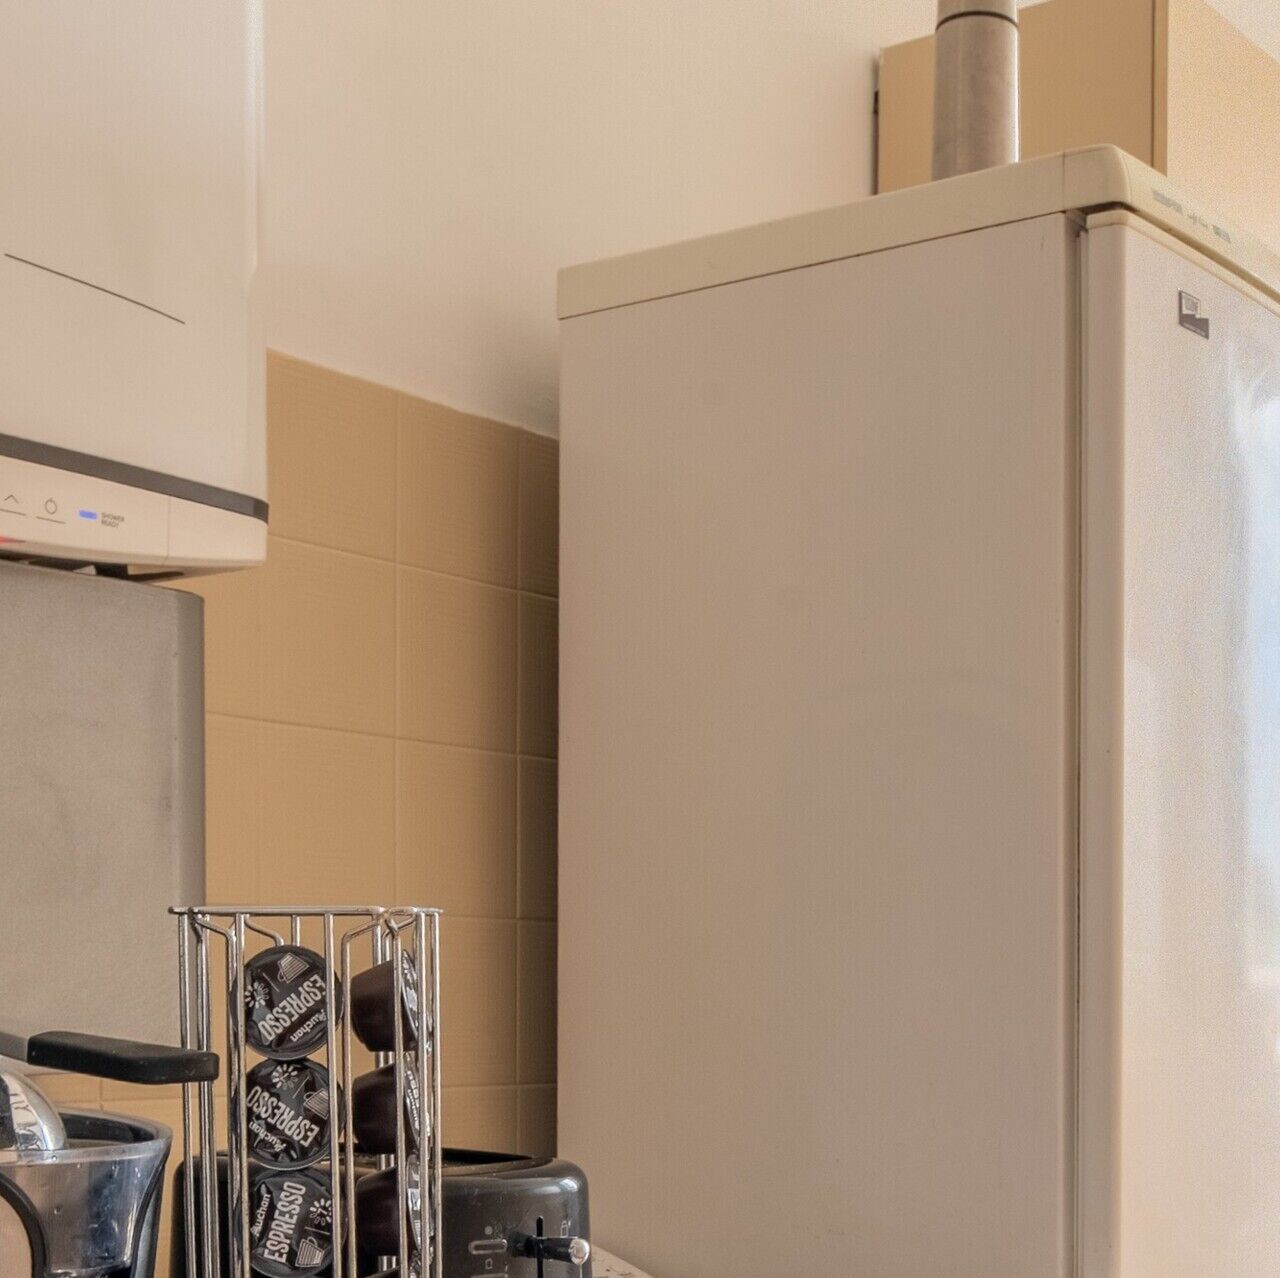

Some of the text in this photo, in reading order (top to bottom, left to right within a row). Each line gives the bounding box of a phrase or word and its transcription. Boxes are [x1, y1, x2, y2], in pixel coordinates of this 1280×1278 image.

[246, 1085, 321, 1148] ESPRESSO
[250, 1193, 272, 1238] Auchan
[263, 1181, 307, 1264] ESPRESSO
